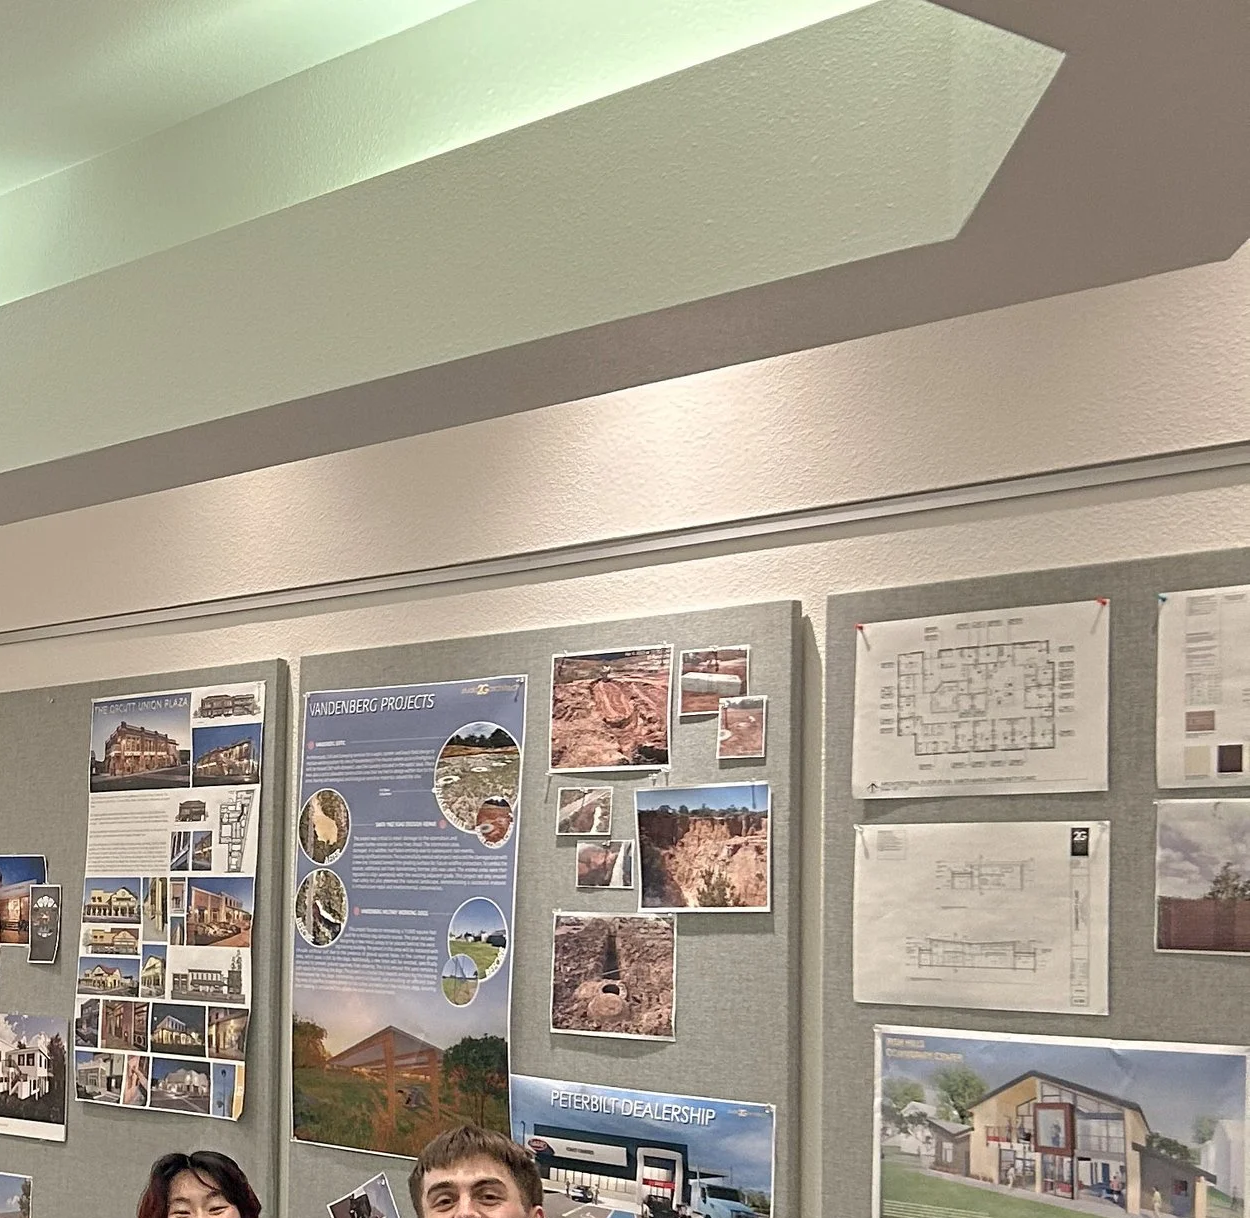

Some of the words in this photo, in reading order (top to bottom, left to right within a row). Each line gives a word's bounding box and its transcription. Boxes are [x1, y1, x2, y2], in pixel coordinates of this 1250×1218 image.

[94, 705, 108, 715] THE
[138, 699, 162, 711] UNION
[164, 697, 188, 709] PLAZA
[309, 698, 378, 717] VANDENBERG
[380, 694, 436, 713] PROJECTS
[1073, 831, 1088, 841] 2G
[551, 1090, 619, 1114] PETERBILT
[622, 1100, 716, 1126] DEALERSHIP
